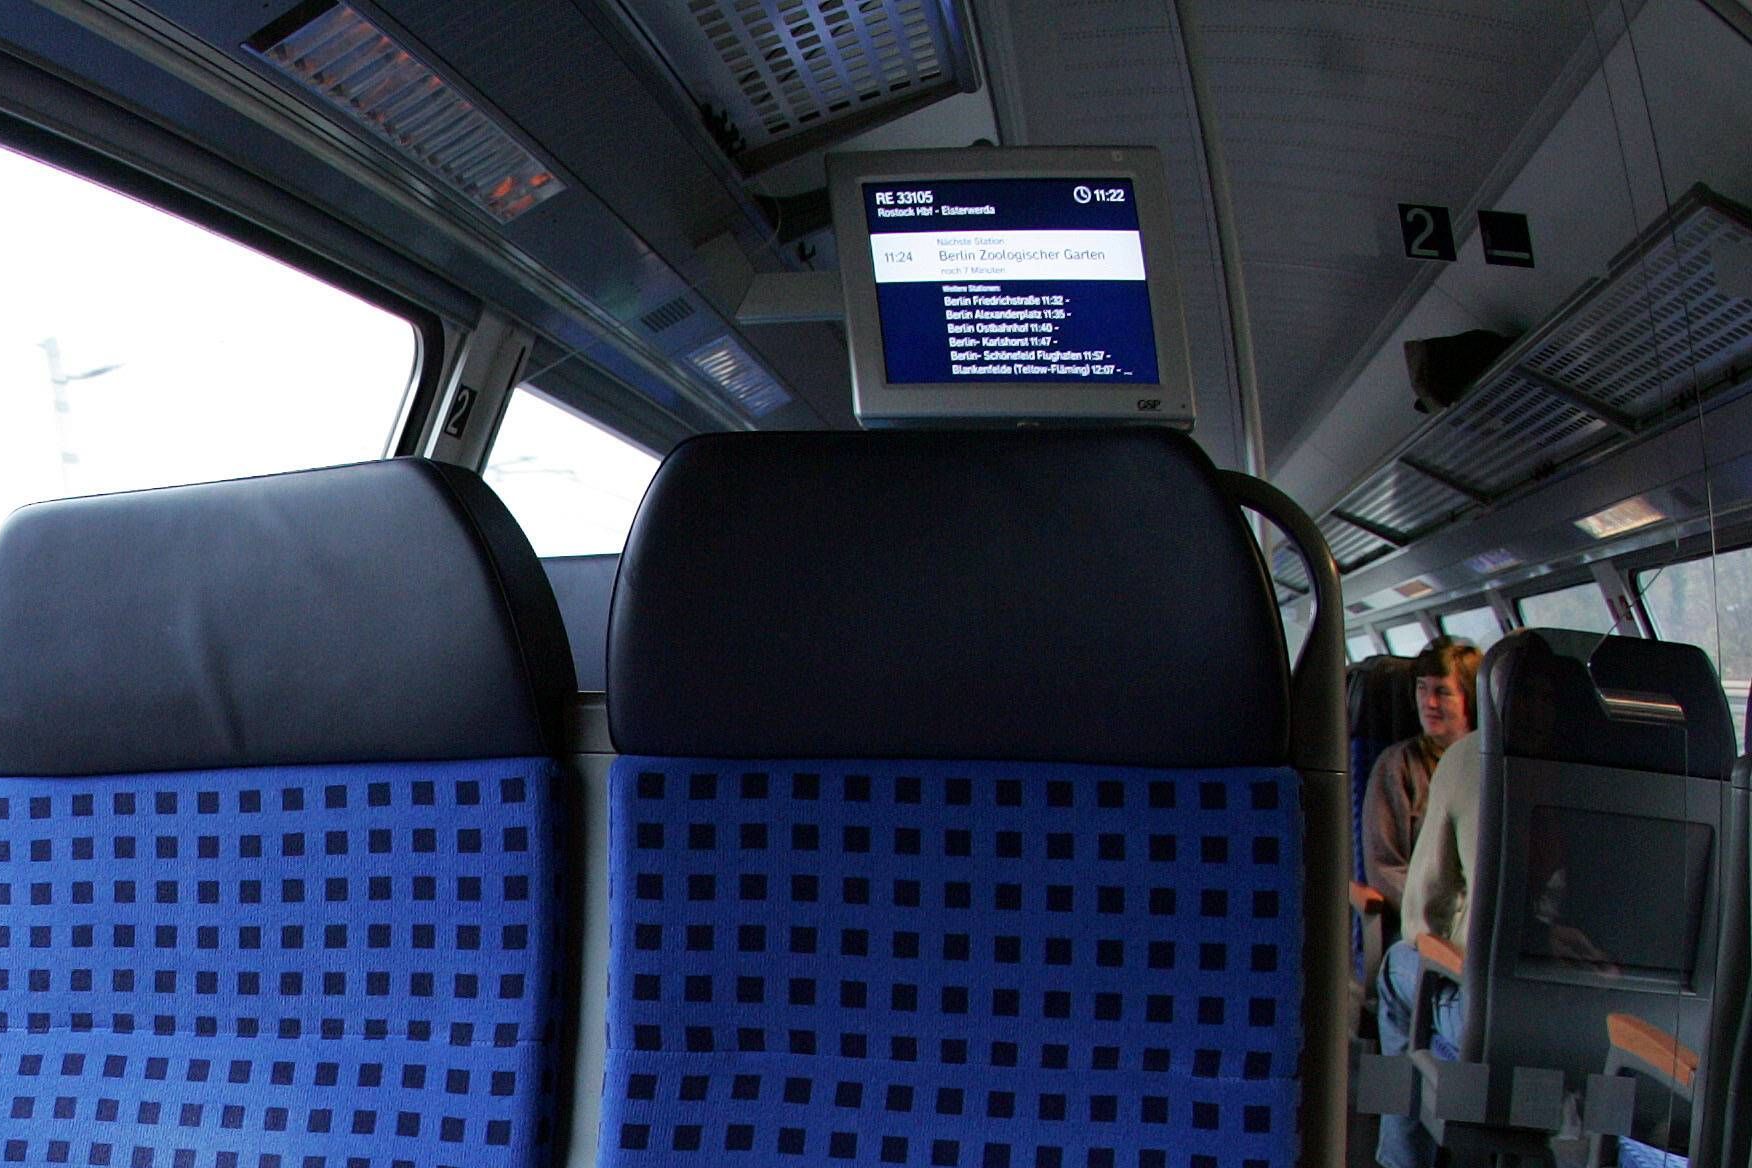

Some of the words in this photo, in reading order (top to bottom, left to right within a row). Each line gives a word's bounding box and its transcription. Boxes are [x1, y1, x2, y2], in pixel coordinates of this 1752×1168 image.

[875, 191, 895, 205] RE
[896, 190, 934, 205] 33105
[1093, 188, 1125, 202] 11:22
[877, 207, 916, 218] Rostock
[916, 206, 934, 217] Hbf
[941, 205, 996, 216] Elsterwerda
[1406, 207, 1440, 257] 2
[884, 251, 913, 263] 11:24
[939, 250, 976, 262] Berlin
[979, 248, 1060, 263] Zoologischer
[1064, 248, 1105, 260] Garten
[944, 296, 972, 306] Berlin
[972, 295, 1041, 306] Friedrichstraße
[945, 309, 973, 320] Berlin
[974, 308, 1042, 321] Alexanderplatz
[947, 323, 975, 333] Berlin
[976, 322, 1029, 333] Ostbahnhof
[949, 336, 980, 347] Berlin-
[981, 336, 1030, 347] Karlshorst
[1030, 336, 1052, 346] 11:47
[950, 350, 982, 361] Berlin-
[983, 350, 1036, 361] Schönefeld
[1036, 350, 1083, 362] Flughafen
[952, 364, 1012, 375] Blankenfelde
[1091, 364, 1115, 375] 12:07
[446, 389, 470, 434] 2
